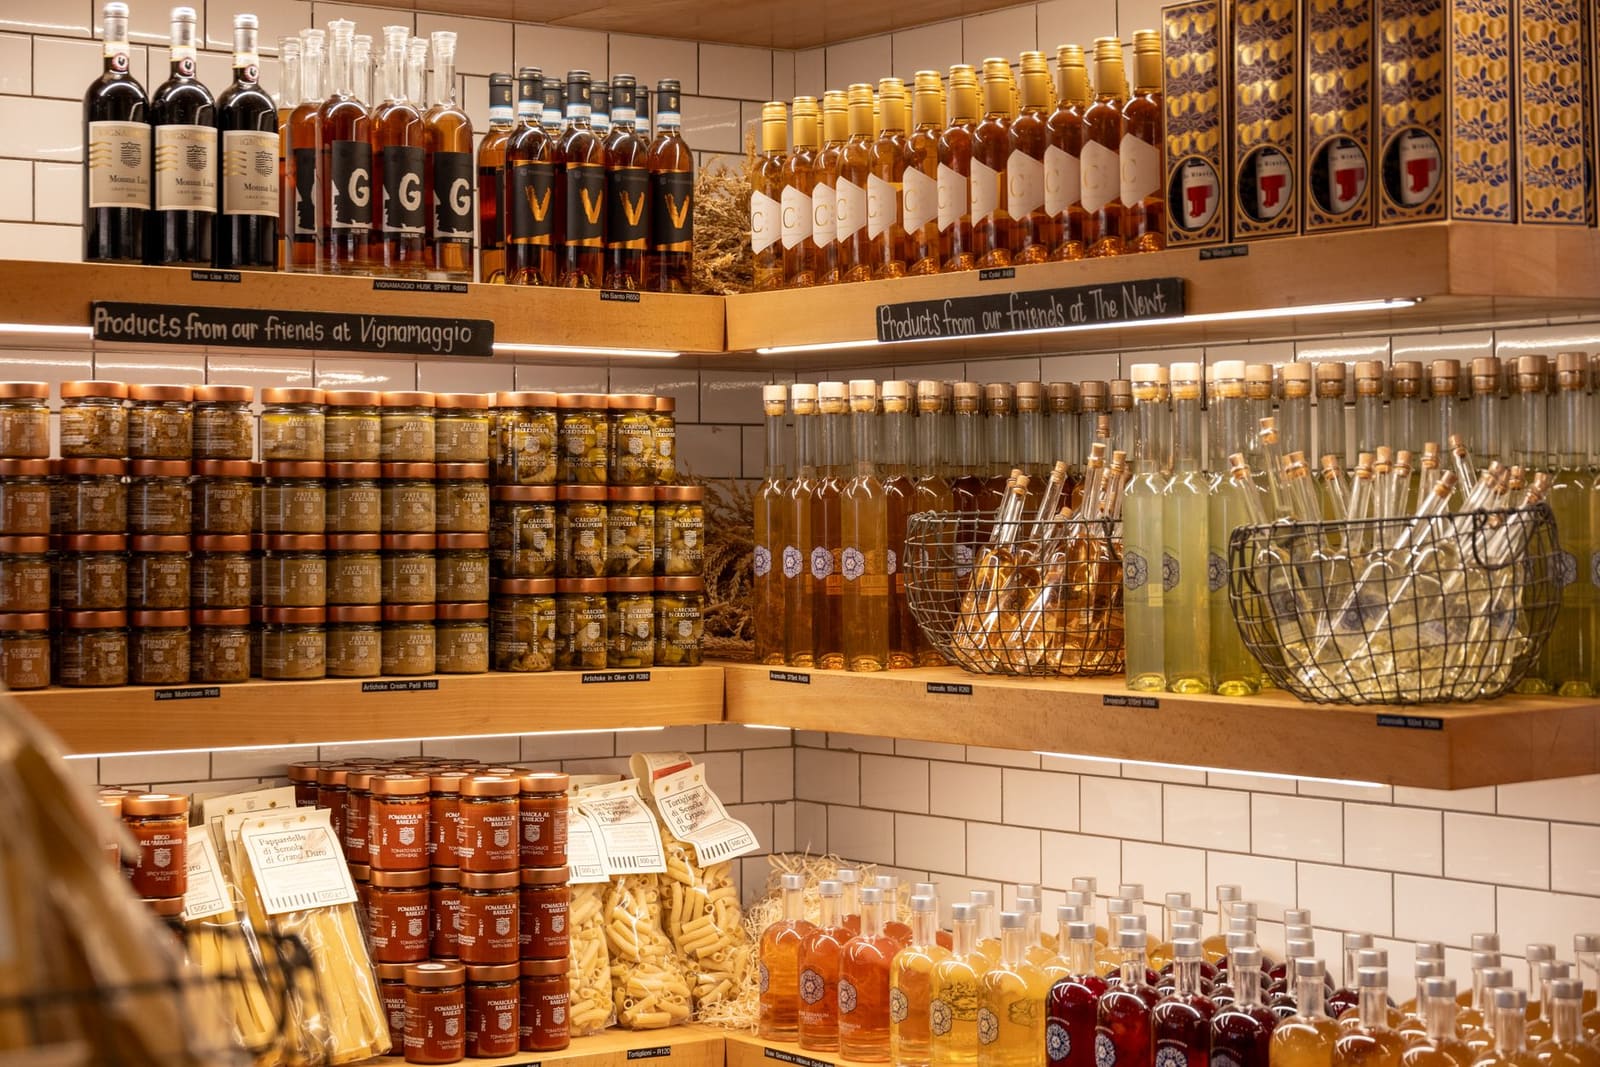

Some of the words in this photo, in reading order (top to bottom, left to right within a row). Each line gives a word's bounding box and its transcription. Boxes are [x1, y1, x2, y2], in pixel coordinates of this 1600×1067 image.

[348, 168, 370, 207] G
[399, 172, 421, 211] G
[450, 178, 471, 216] G
[525, 185, 551, 222] V
[580, 187, 604, 224] V
[619, 190, 645, 226] V
[665, 193, 690, 229] V
[880, 305, 941, 340] Products
[943, 299, 976, 337] from
[982, 312, 1002, 330] our
[1009, 292, 1066, 330] friends
[1070, 294, 1087, 322] at
[1089, 288, 1118, 320] The
[1122, 284, 1167, 319] Newt
[94, 307, 182, 338] Products
[185, 312, 228, 340] from
[232, 321, 259, 340] our
[264, 316, 324, 343] friends
[333, 322, 352, 342] at
[360, 317, 473, 352] Vignamaggio
[174, 690, 204, 698] Mushroom
[364, 683, 388, 691] Artichoke
[665, 790, 701, 808] Tortiglioni
[678, 801, 703, 814] Semola
[684, 810, 706, 821] Grano
[258, 834, 306, 846] Pappardelle
[274, 844, 303, 854] Semola
[188, 864, 201, 872] uro
[266, 856, 274, 864] di
[277, 852, 304, 862] Grano
[306, 850, 327, 858] Duro
